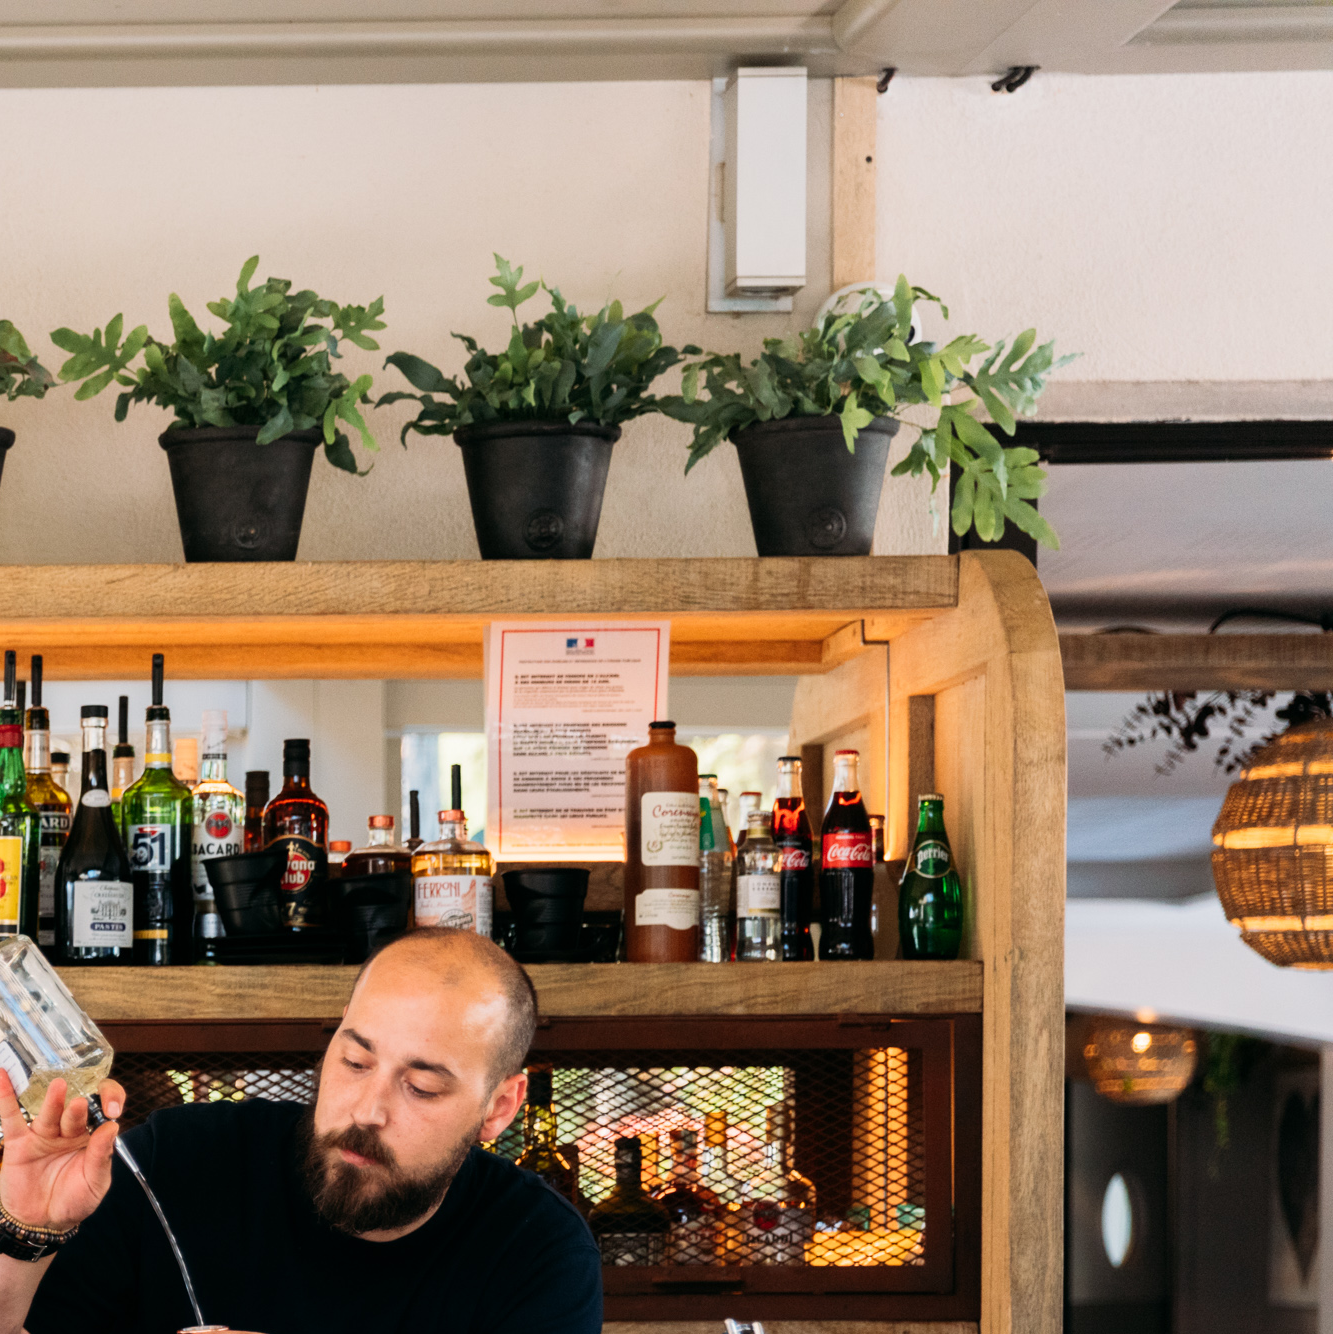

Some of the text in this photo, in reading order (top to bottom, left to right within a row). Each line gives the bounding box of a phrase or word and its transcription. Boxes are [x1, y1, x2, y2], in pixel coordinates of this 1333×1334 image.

[42, 817, 69, 828] ARD
[132, 832, 166, 866] 51
[827, 843, 872, 862] Coca-Cola
[418, 882, 461, 899] FERRONI
